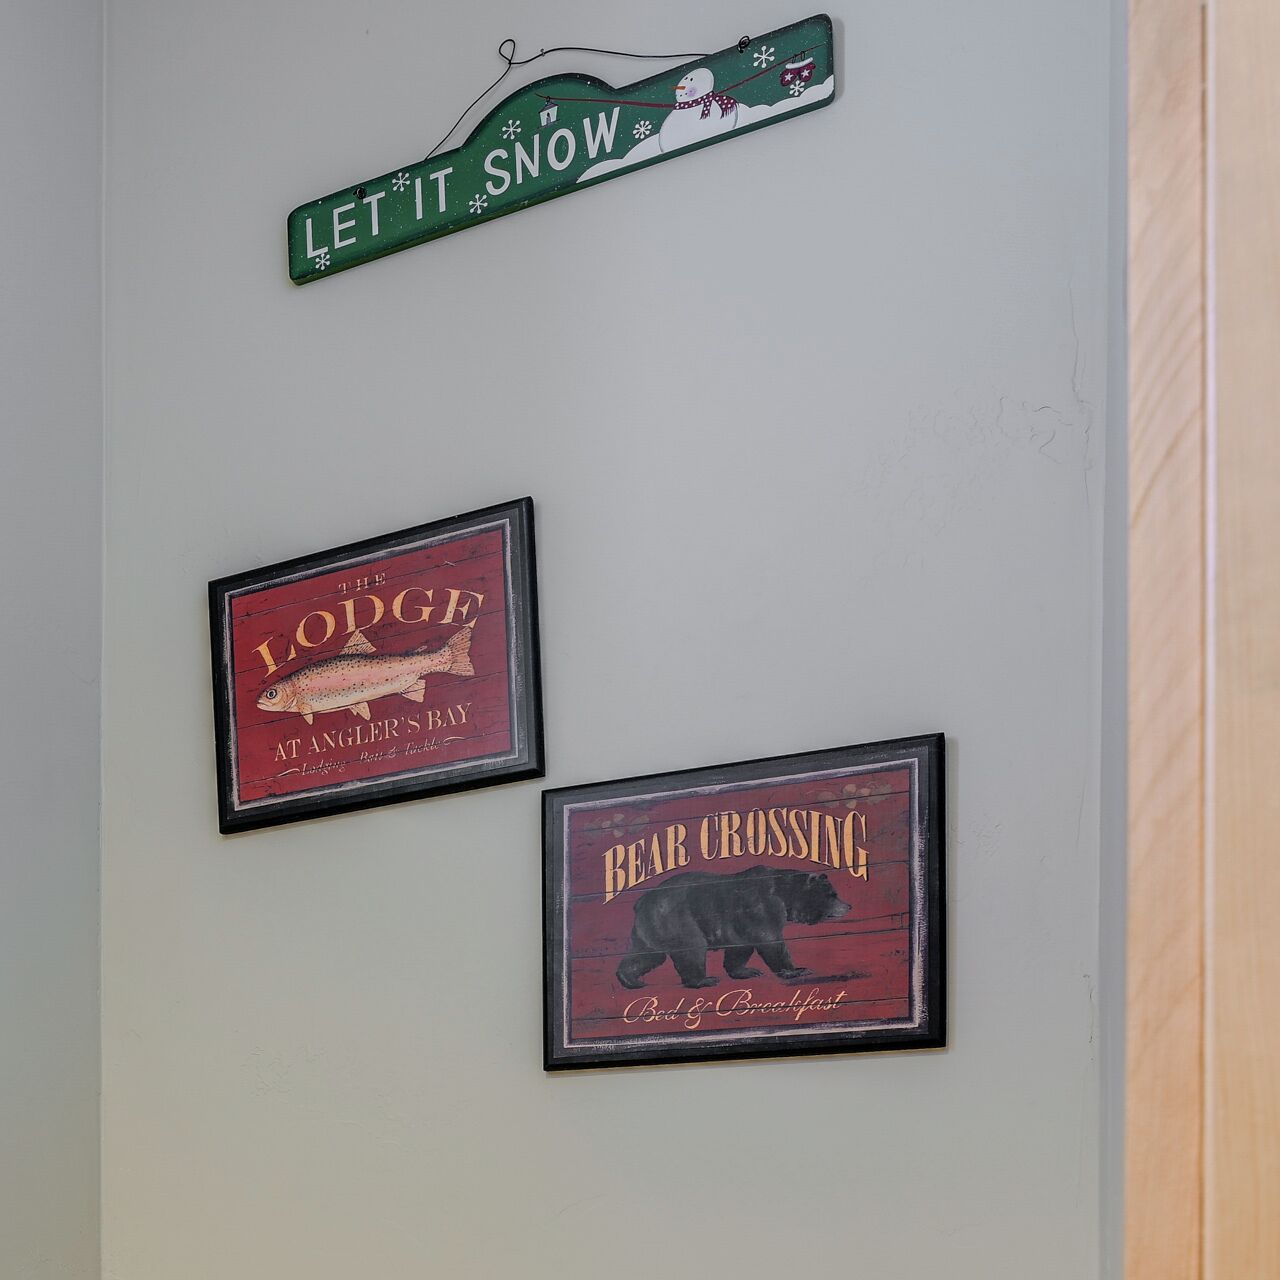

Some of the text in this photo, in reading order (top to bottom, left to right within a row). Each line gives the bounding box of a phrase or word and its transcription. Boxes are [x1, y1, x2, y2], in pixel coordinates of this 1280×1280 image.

[305, 107, 621, 259] LET IT SNOW
[338, 573, 387, 594] THE
[252, 586, 485, 678] LODGE
[274, 702, 473, 761] AT ANGLER'S BAY
[602, 806, 869, 905] BEAR CROSSING
[623, 986, 848, 1030] Bed & Breakfast
